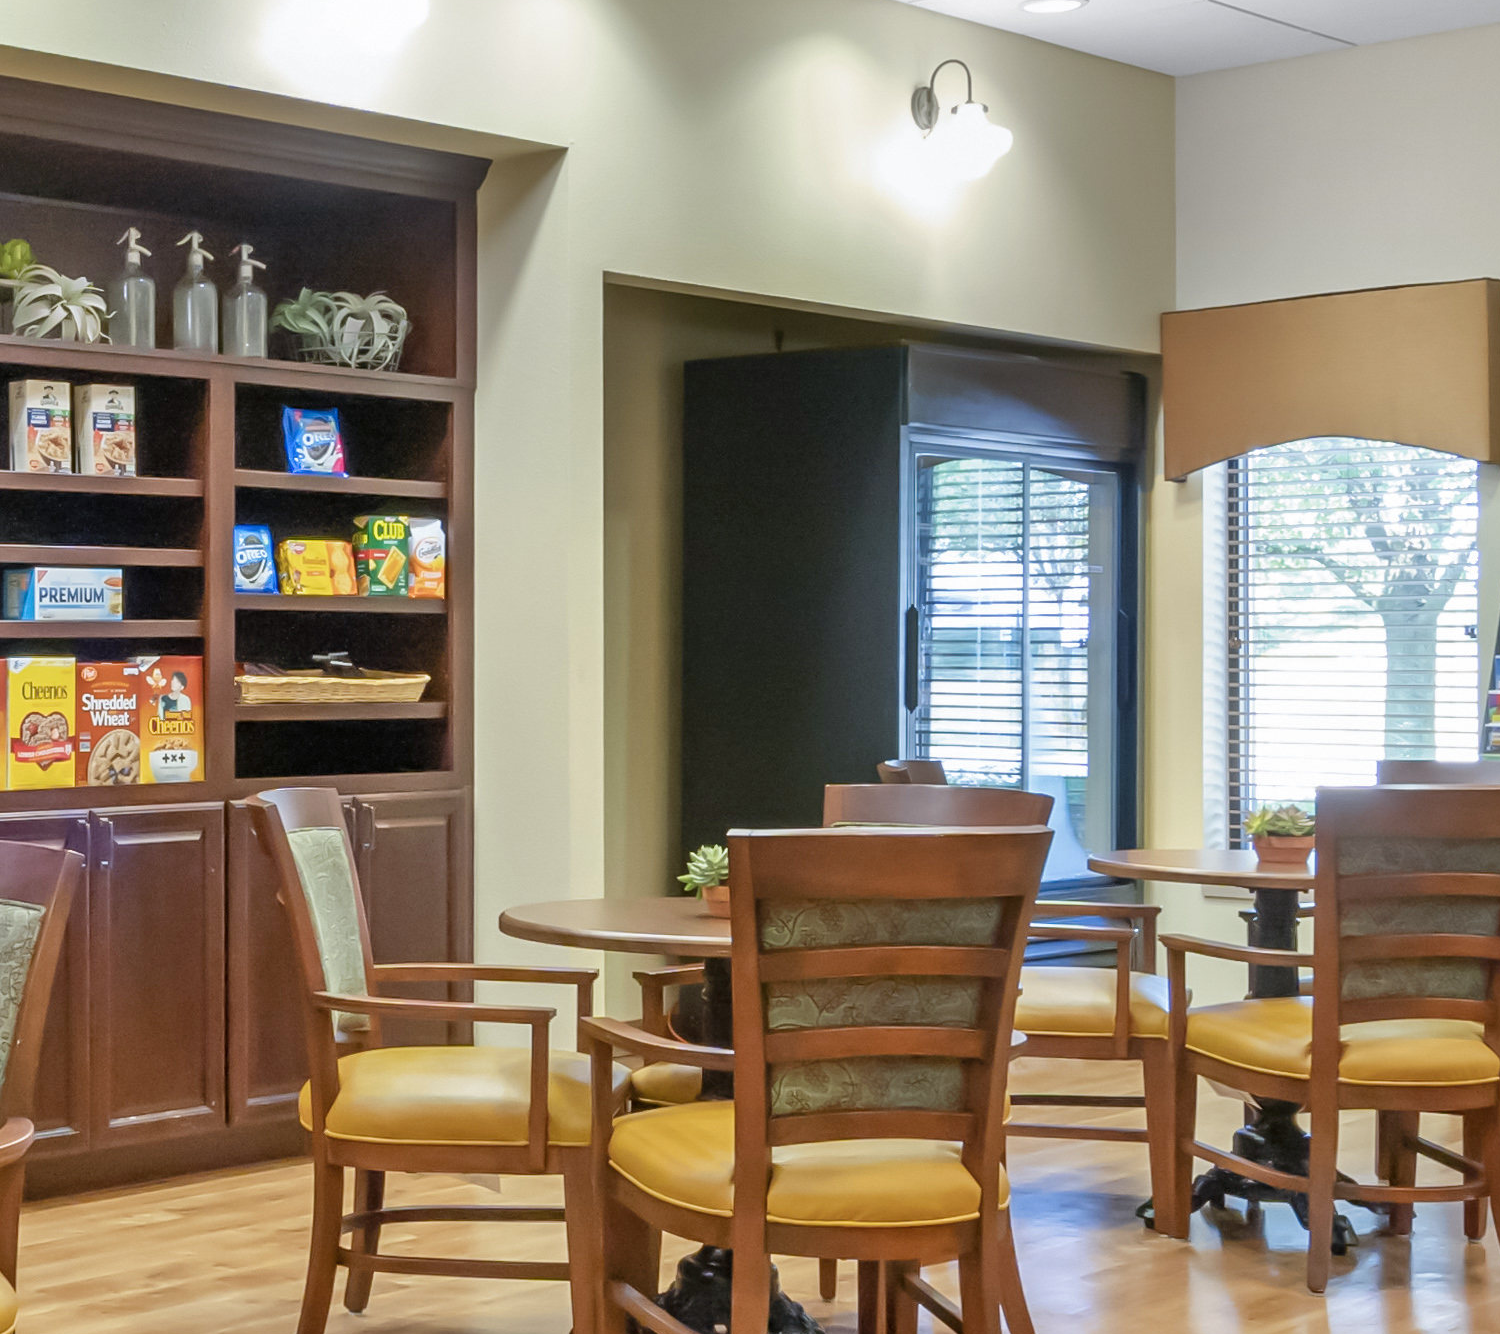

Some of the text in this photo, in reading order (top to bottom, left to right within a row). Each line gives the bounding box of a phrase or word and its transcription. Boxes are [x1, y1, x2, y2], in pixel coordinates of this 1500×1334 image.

[373, 519, 405, 541] CLUB
[235, 548, 268, 565] OREO
[39, 587, 105, 603] PREMIUM
[21, 681, 68, 700] Cheerios
[81, 693, 137, 711] Shredded
[90, 710, 130, 727] Wheat
[148, 716, 195, 735] Cheerios
